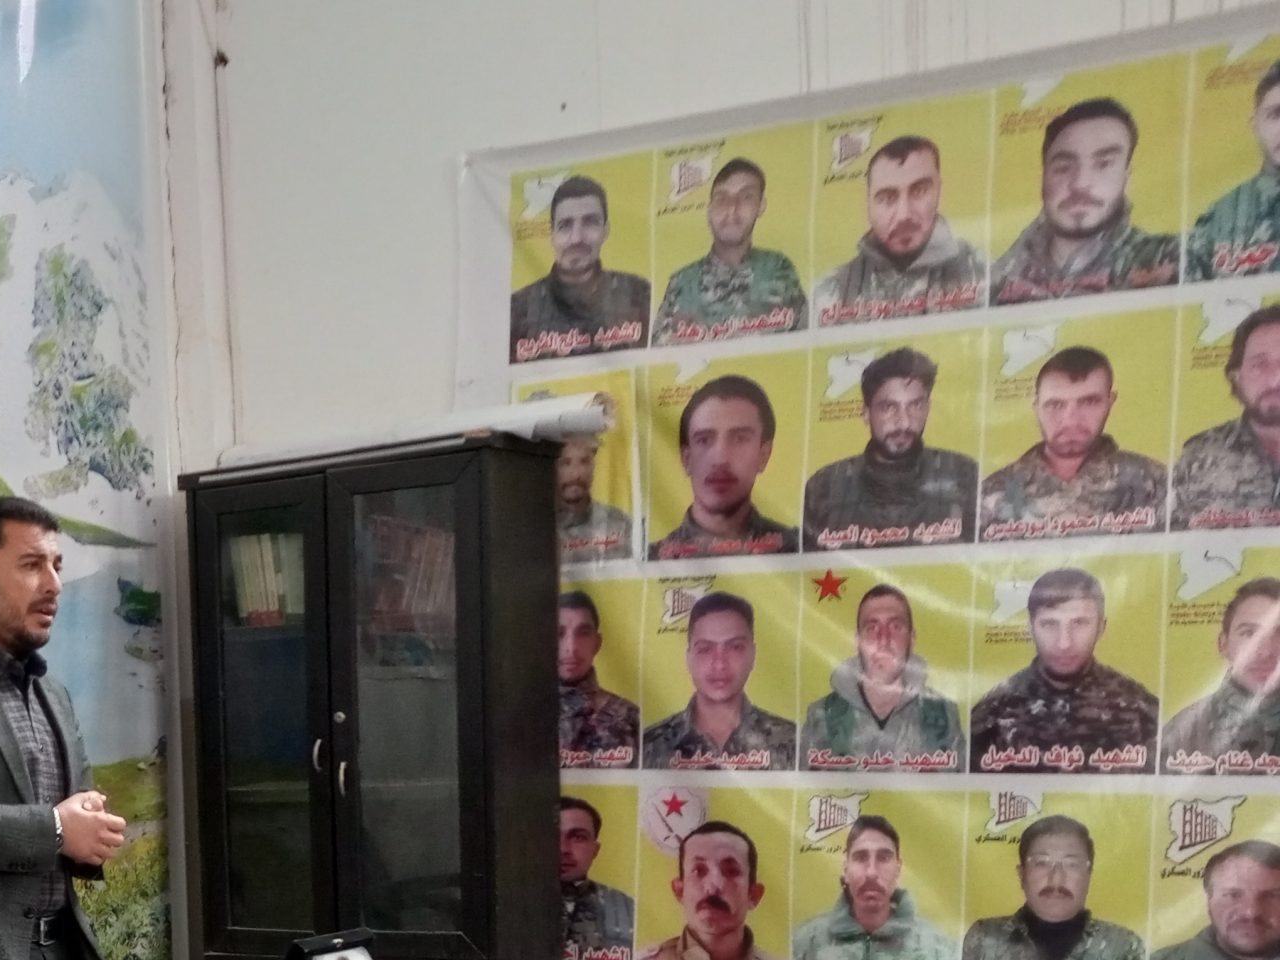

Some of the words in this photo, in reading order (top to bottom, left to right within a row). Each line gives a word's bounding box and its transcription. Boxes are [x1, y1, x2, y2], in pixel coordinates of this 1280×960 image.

[594, 321, 642, 351] الشهيد
[913, 518, 963, 545] الشهيد
[1100, 507, 1156, 533] الشهيد
[593, 746, 634, 767] الشهيد
[716, 749, 771, 769] الشهيد
[897, 749, 958, 770] الشهيد
[1088, 744, 1148, 771] الشهيد
